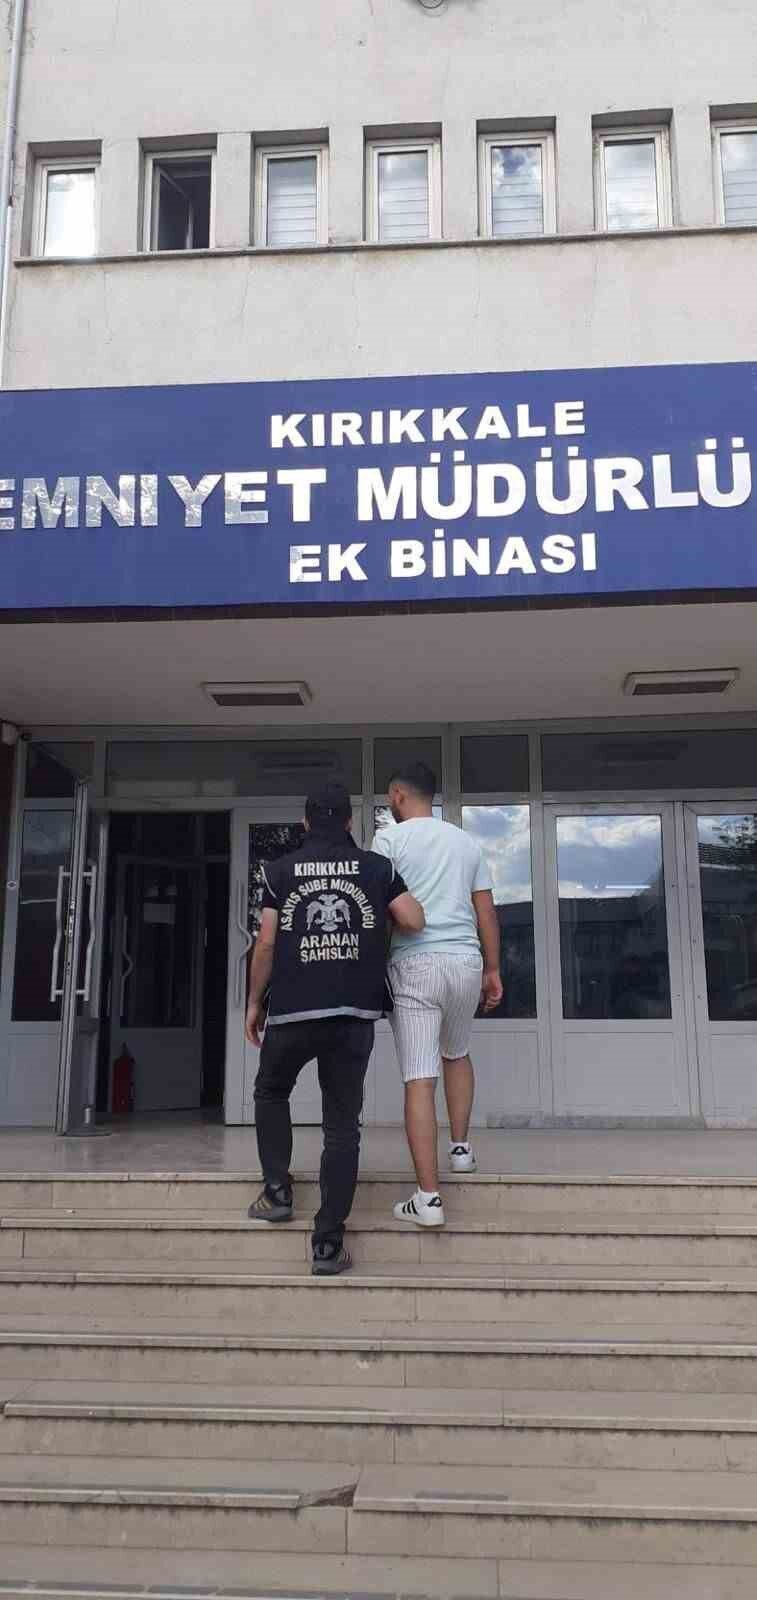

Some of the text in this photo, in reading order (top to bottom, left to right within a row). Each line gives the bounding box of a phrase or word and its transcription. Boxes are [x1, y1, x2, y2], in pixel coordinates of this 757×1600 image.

[270, 401, 586, 448] KIRIKKALE
[357, 438, 752, 520] MÜDÜRLÜ
[290, 529, 597, 582] EK BİNASI
[294, 861, 360, 877] KIRIKKALE
[300, 933, 359, 949] ARANAN
